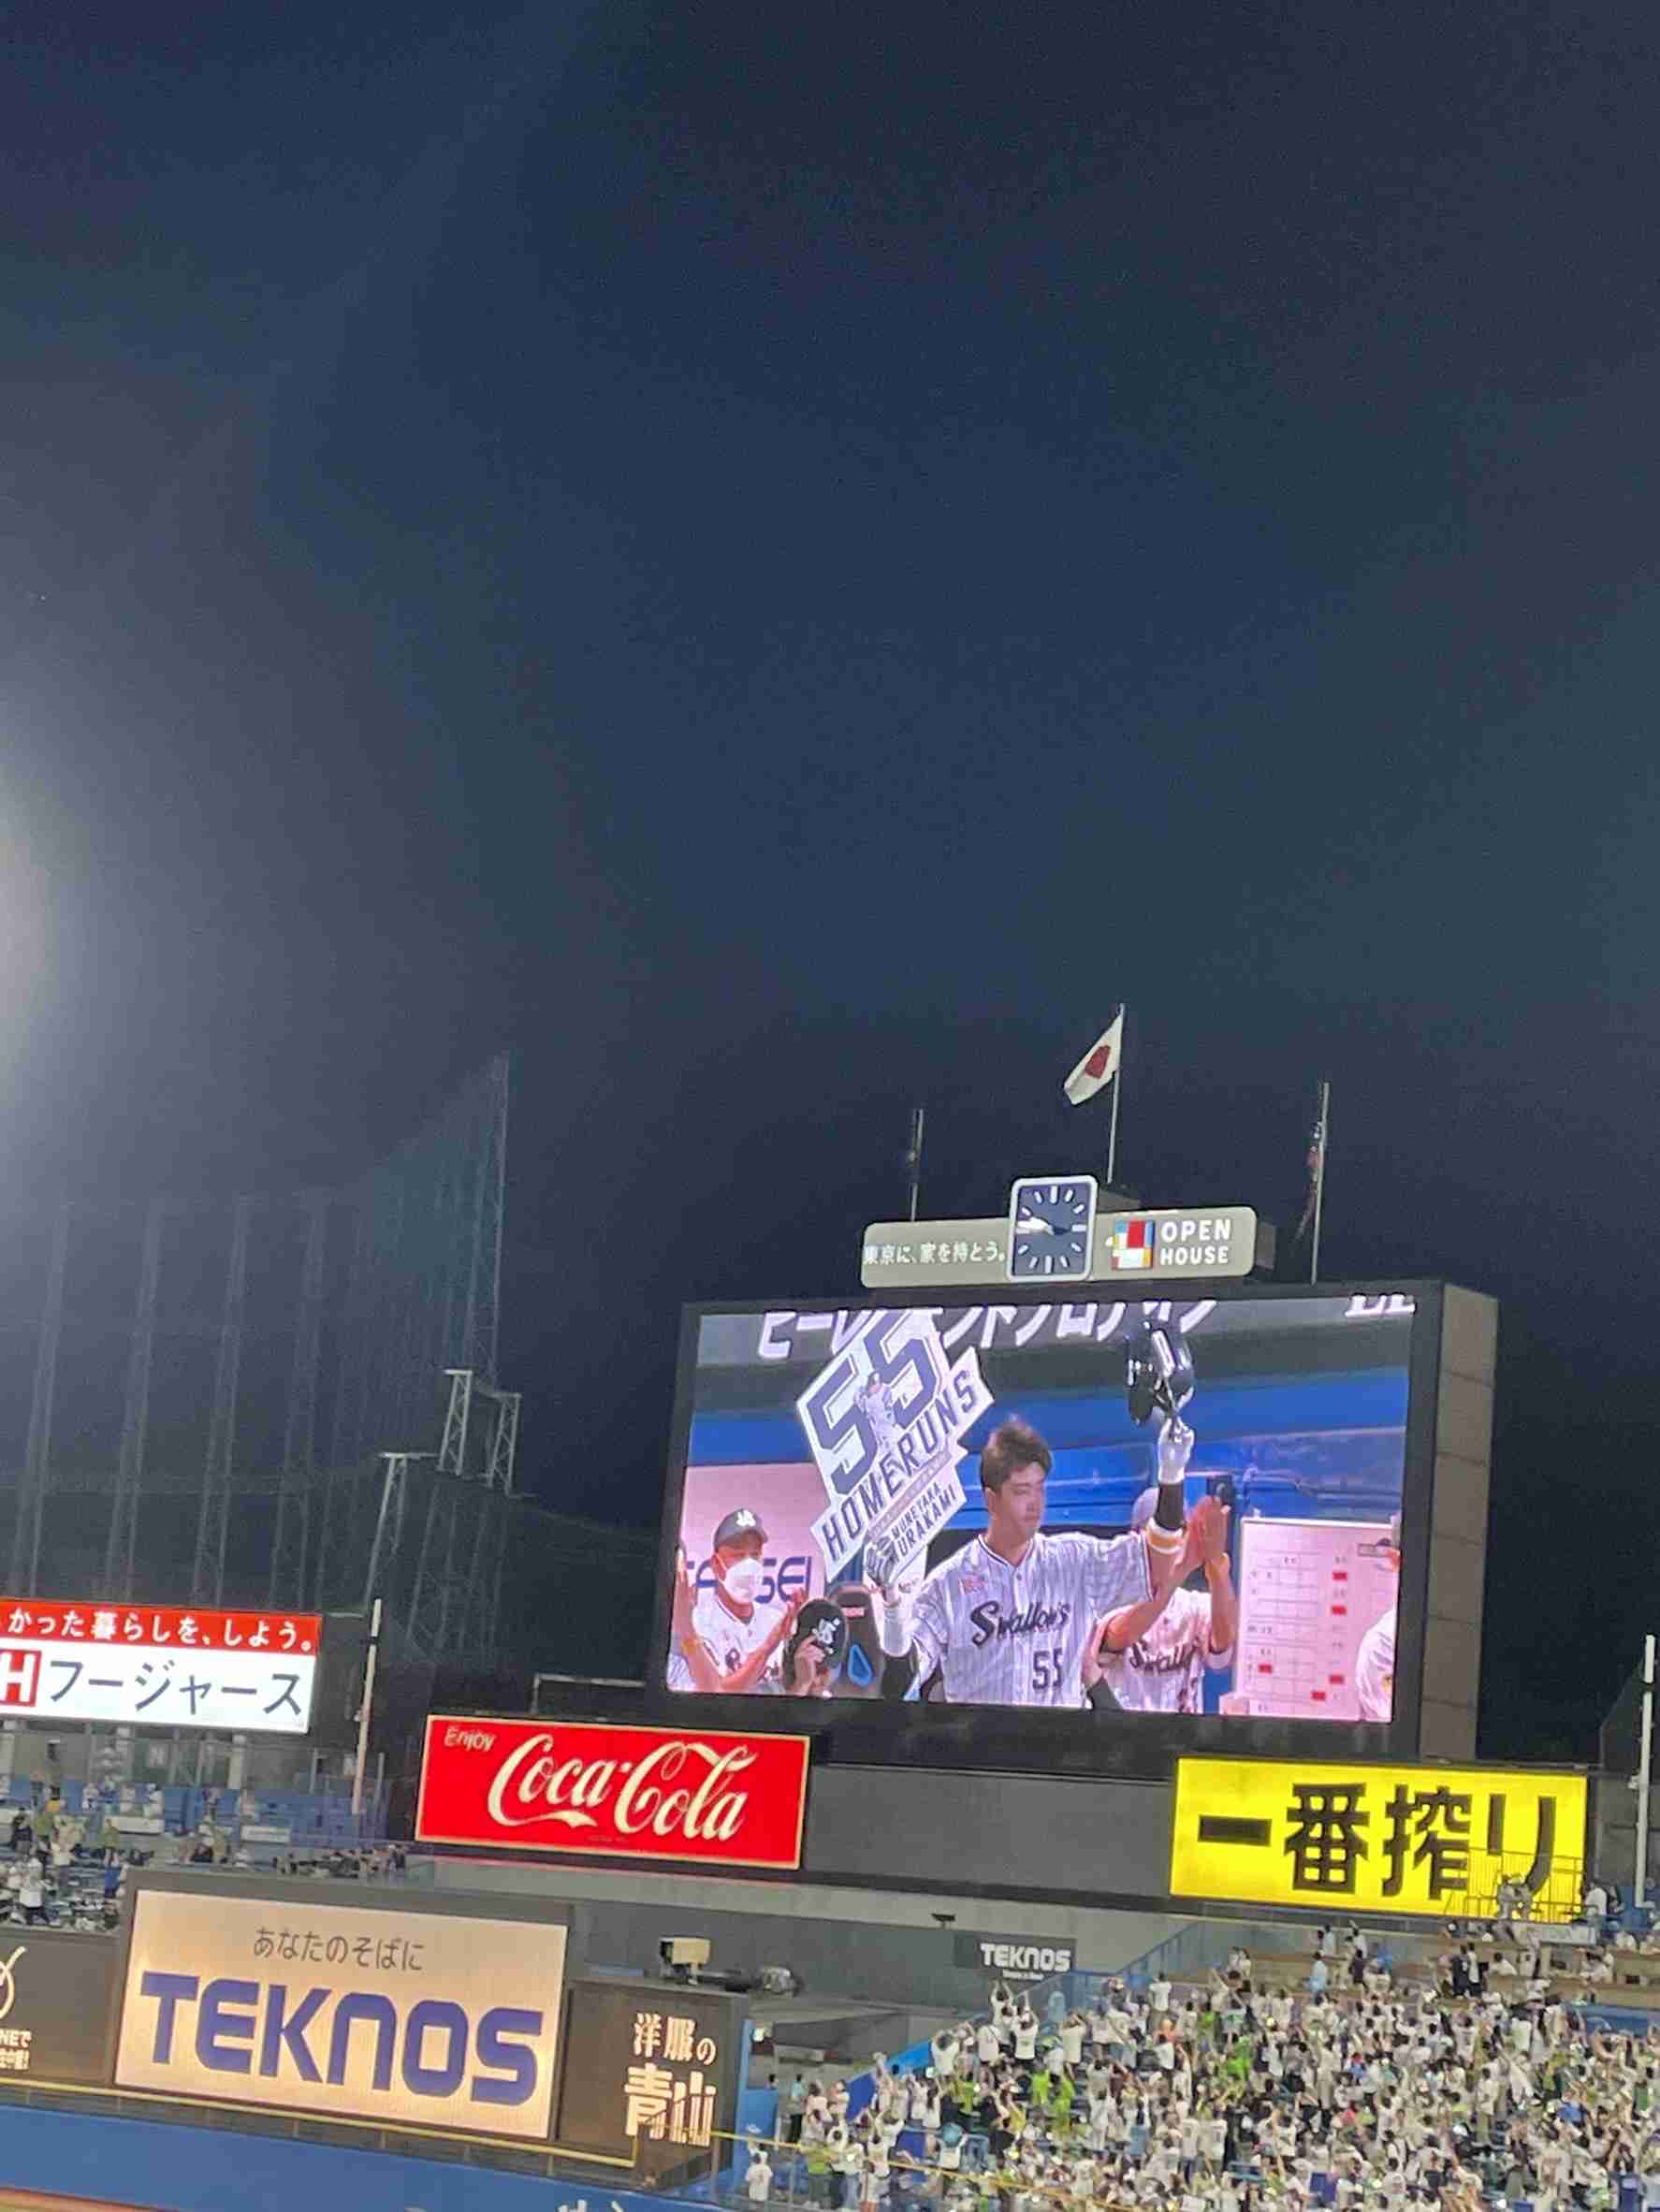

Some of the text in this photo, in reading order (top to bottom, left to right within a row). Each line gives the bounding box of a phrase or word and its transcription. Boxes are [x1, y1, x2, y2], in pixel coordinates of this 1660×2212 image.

[1161, 1218, 1231, 1243] OPEN
[1160, 1245, 1229, 1266] HOUSE
[807, 1310, 937, 1495] 55
[51, 1660, 302, 1715] フージャース
[1032, 1648, 1064, 1690] 55
[444, 1726, 497, 1753] Enjoy
[1197, 1781, 1557, 1900] 一番搾り
[254, 1927, 426, 1972] あなたのそばに
[980, 1943, 1071, 1972] TEKNOS
[141, 1971, 545, 2106] TEKNOS
[633, 2012, 717, 2066] 洋服の
[624, 2062, 717, 2147] 青山
